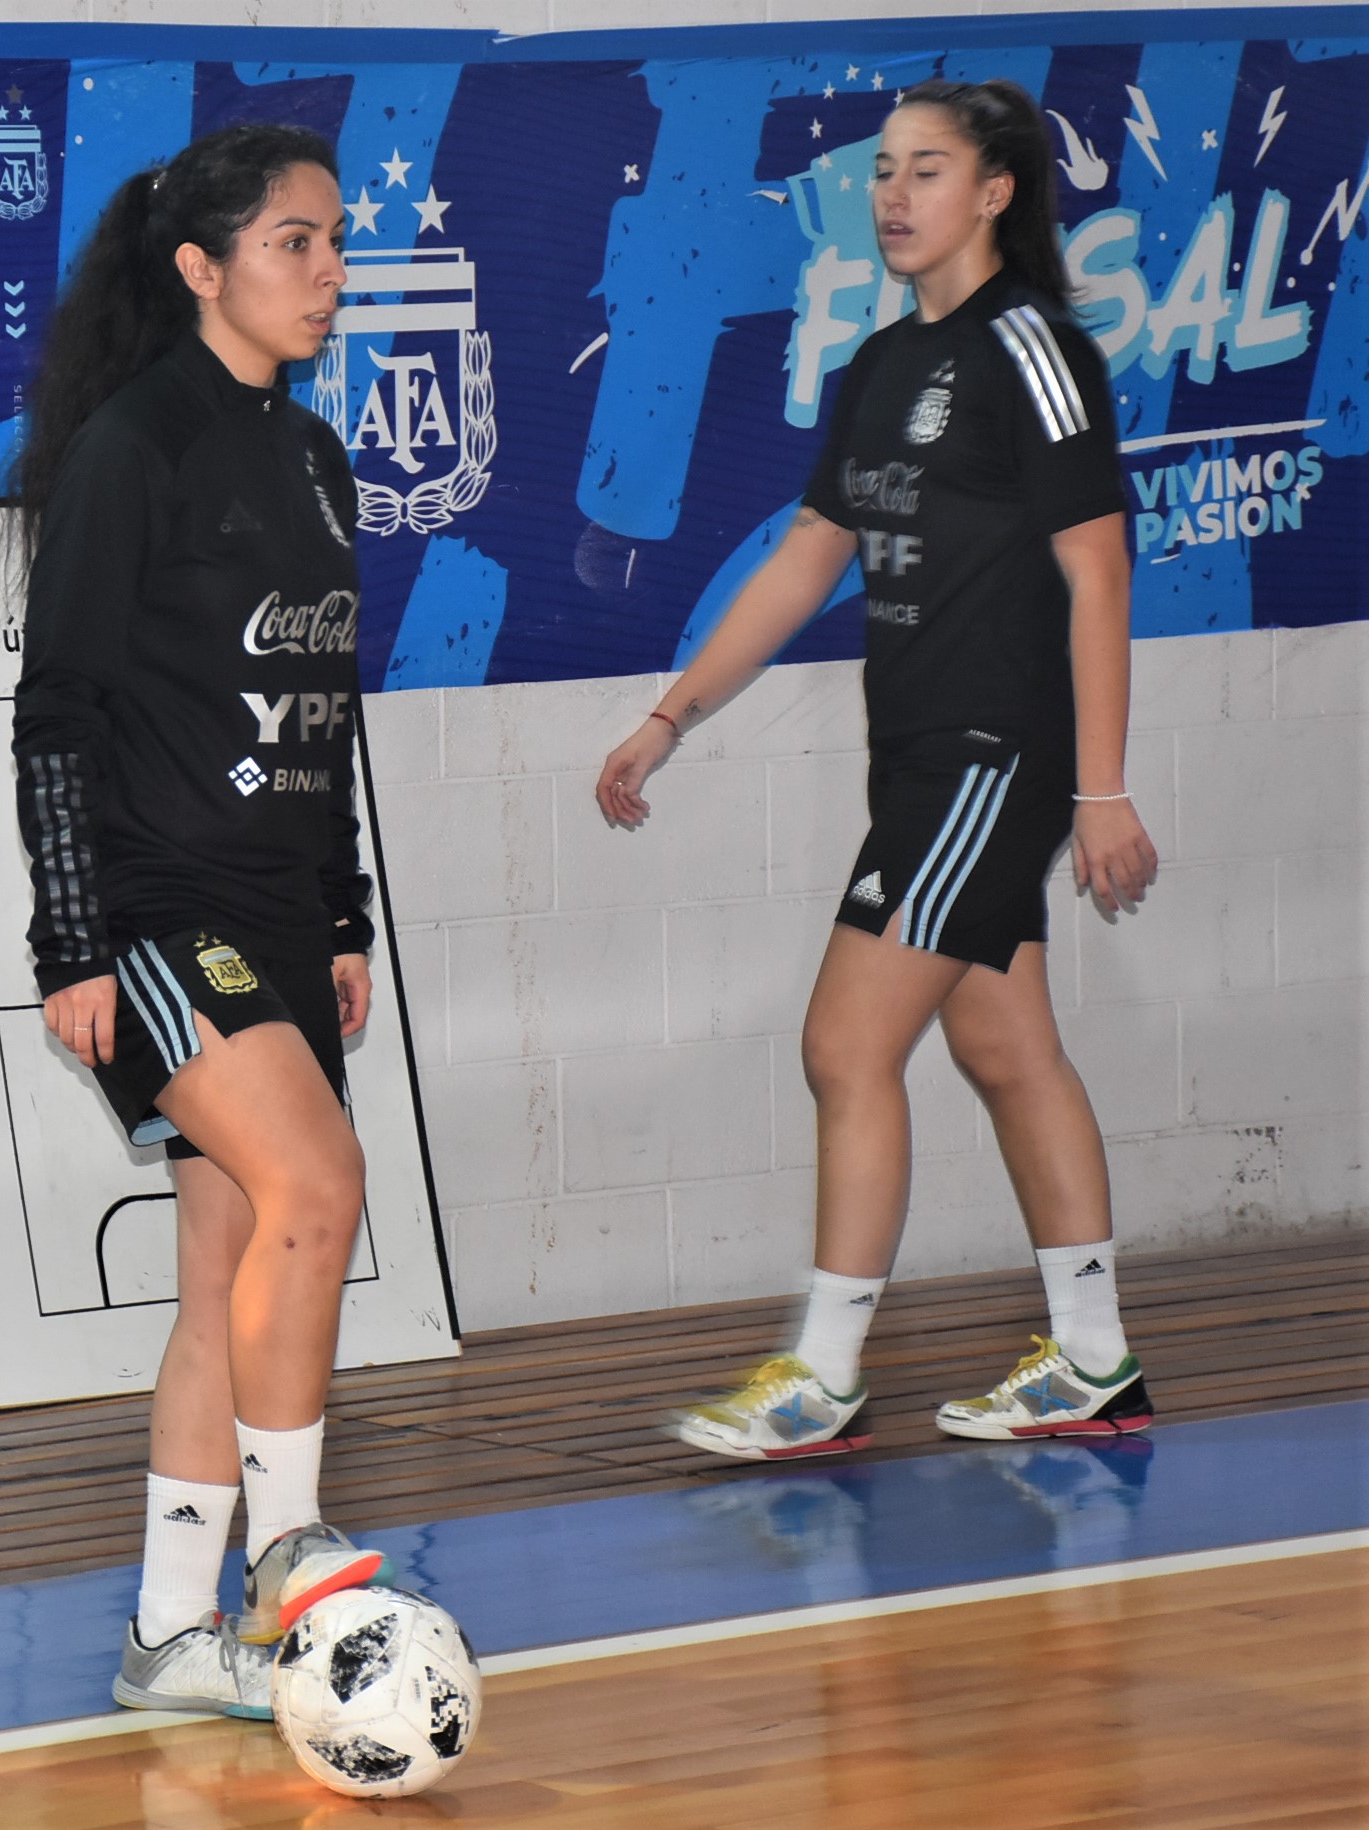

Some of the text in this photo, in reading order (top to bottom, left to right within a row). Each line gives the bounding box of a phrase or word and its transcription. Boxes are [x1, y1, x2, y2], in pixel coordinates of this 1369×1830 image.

[784, 186, 1313, 429] FSAL
[345, 345, 458, 475] AFA
[1130, 445, 1324, 511] VIVIMOS
[858, 528, 923, 576] PF
[1135, 491, 1303, 554] PASION
[240, 692, 350, 744] YPF
